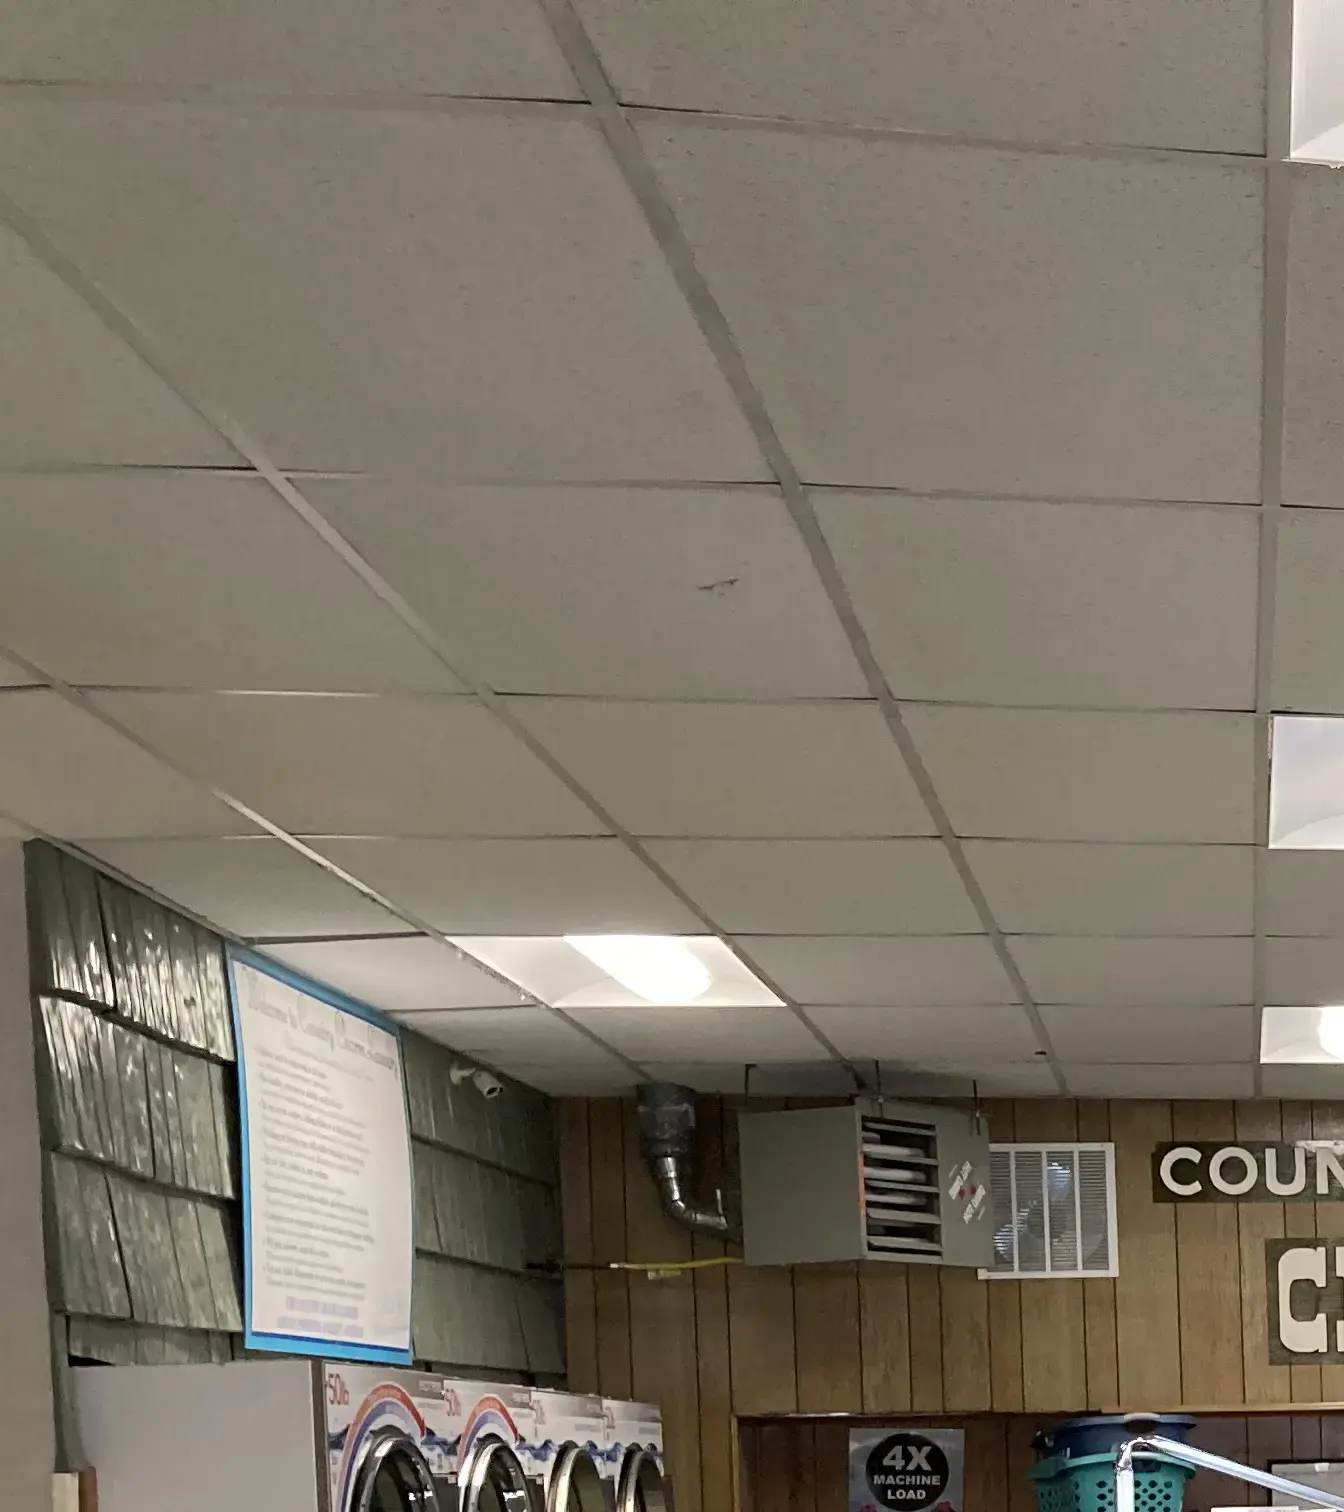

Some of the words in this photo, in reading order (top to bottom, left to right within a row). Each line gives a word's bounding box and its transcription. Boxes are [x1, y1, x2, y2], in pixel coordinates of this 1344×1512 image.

[882, 1445, 932, 1471] 4X
[873, 1475, 941, 1486] MACHINE
[887, 1489, 926, 1500] LOAD
